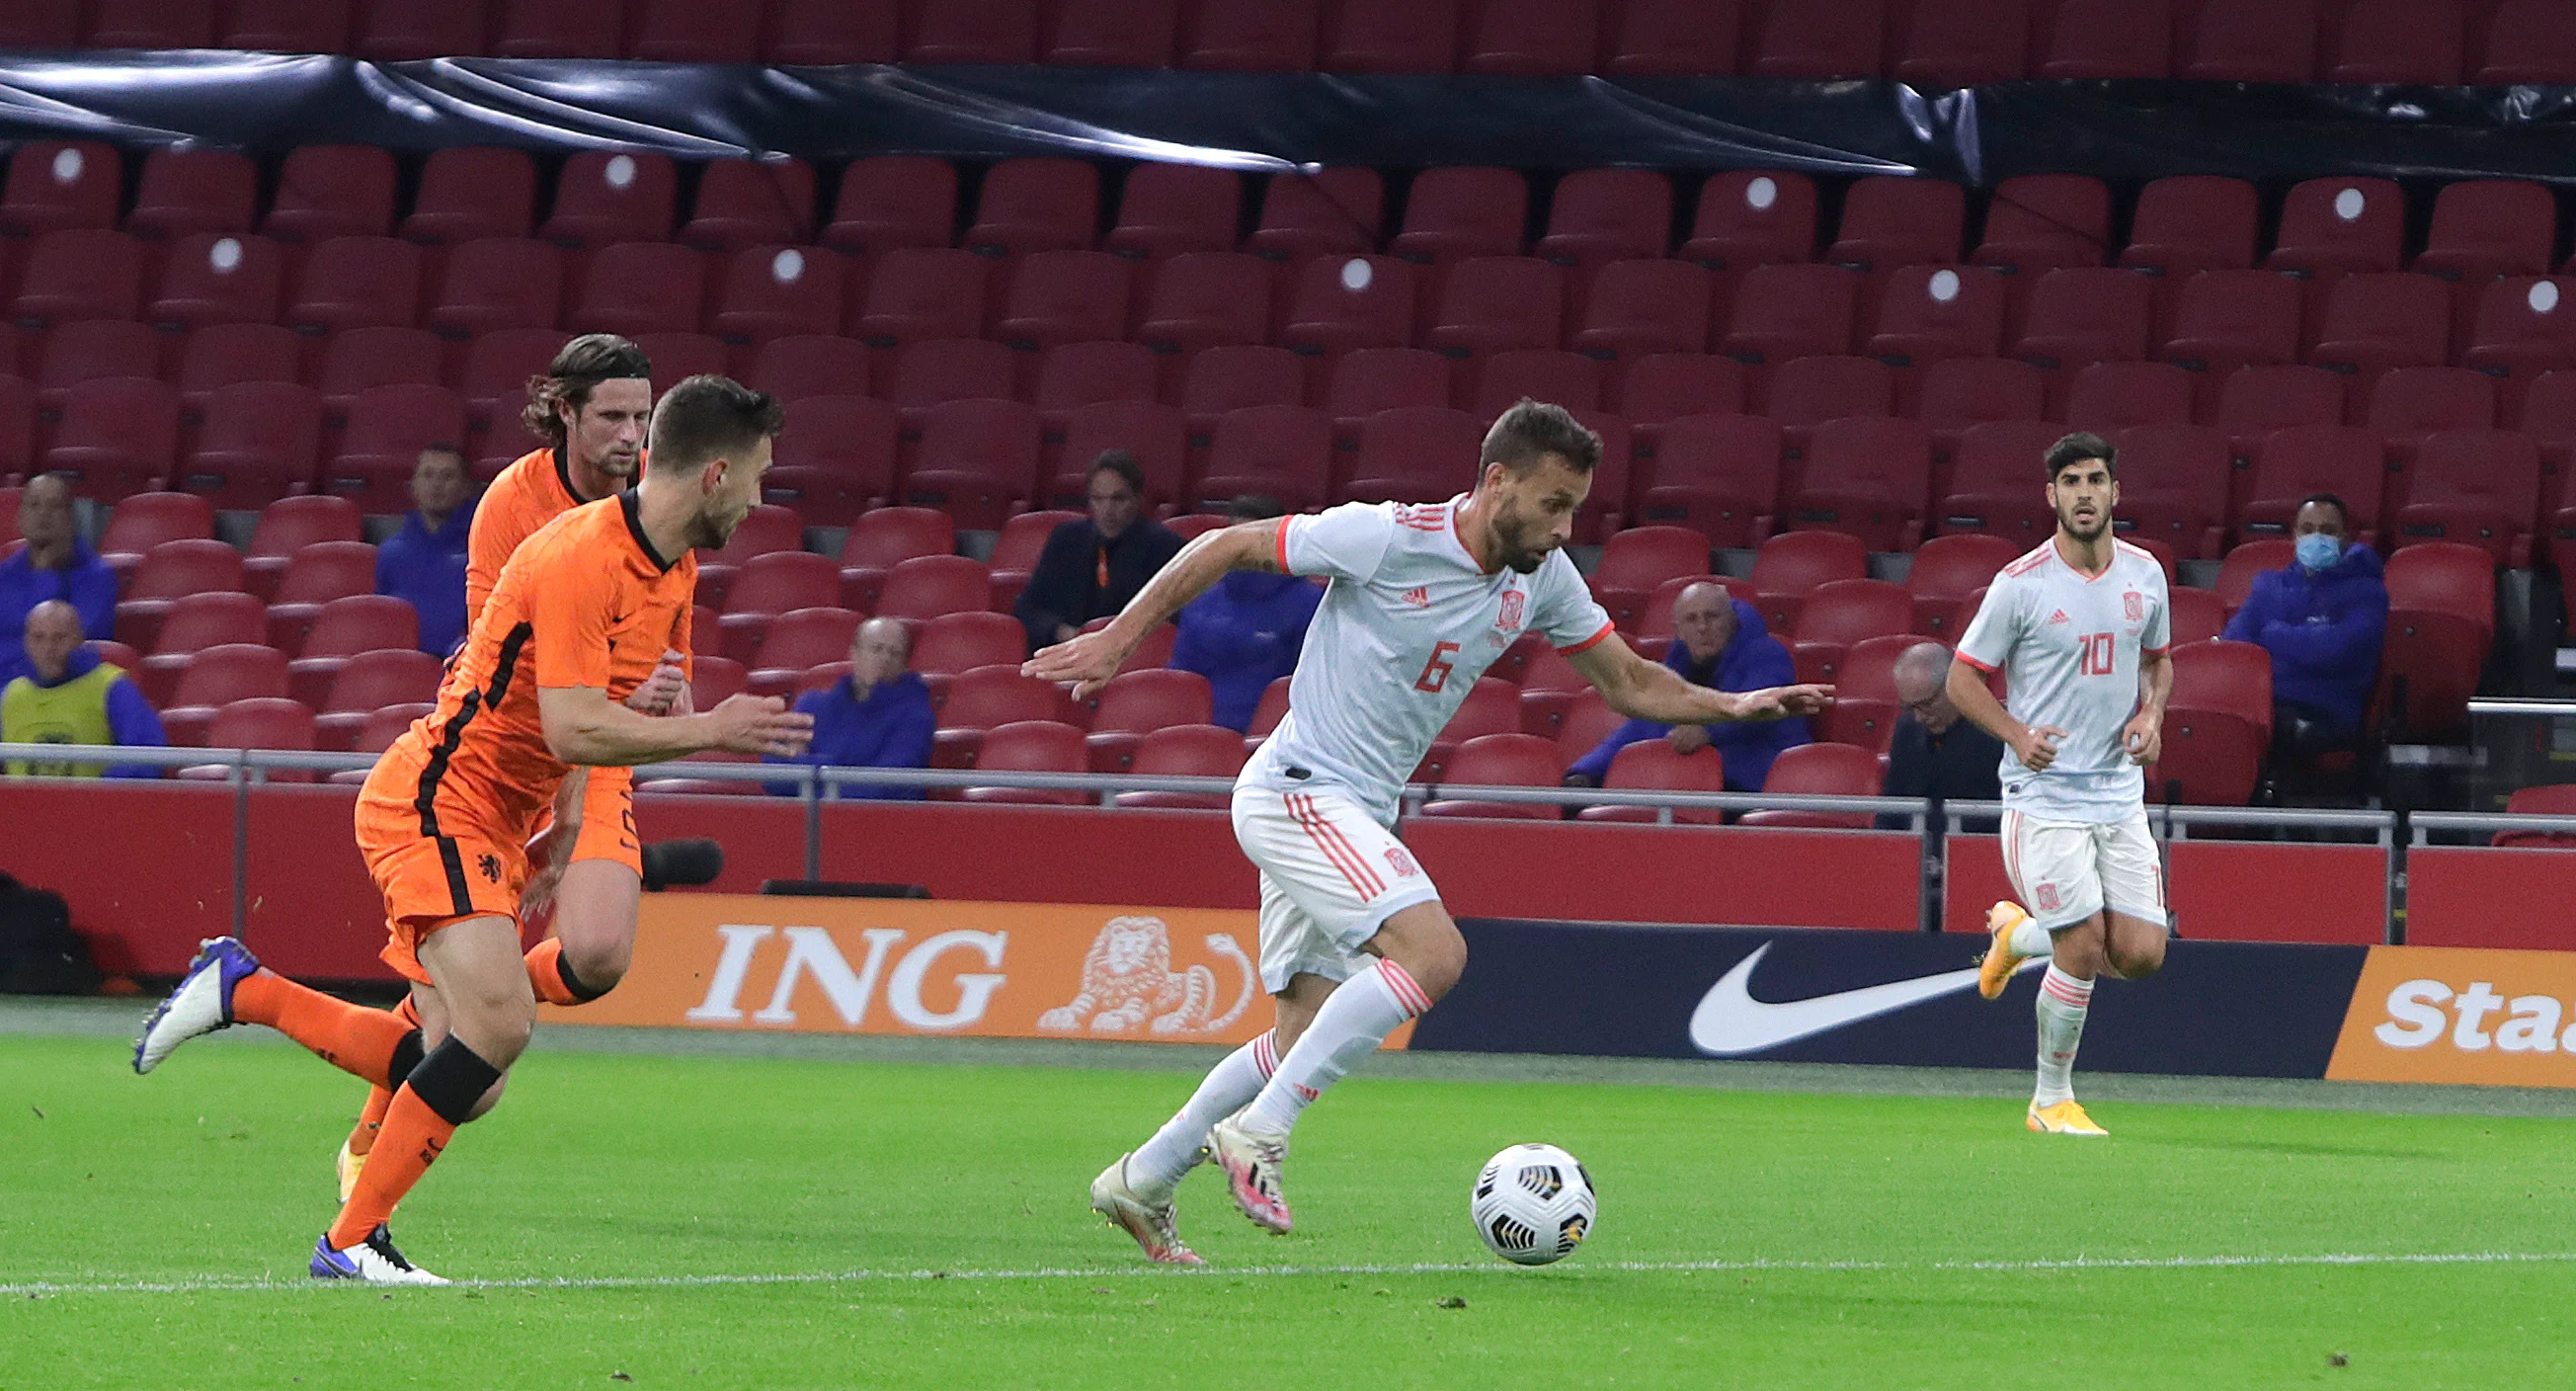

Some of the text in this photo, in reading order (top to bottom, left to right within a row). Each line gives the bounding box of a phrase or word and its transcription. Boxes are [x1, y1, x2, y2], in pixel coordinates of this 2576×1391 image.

[1414, 640, 1462, 694] 6
[2078, 632, 2115, 676] 10
[687, 925, 1007, 1029] ING
[2374, 979, 2576, 1054] Sta
